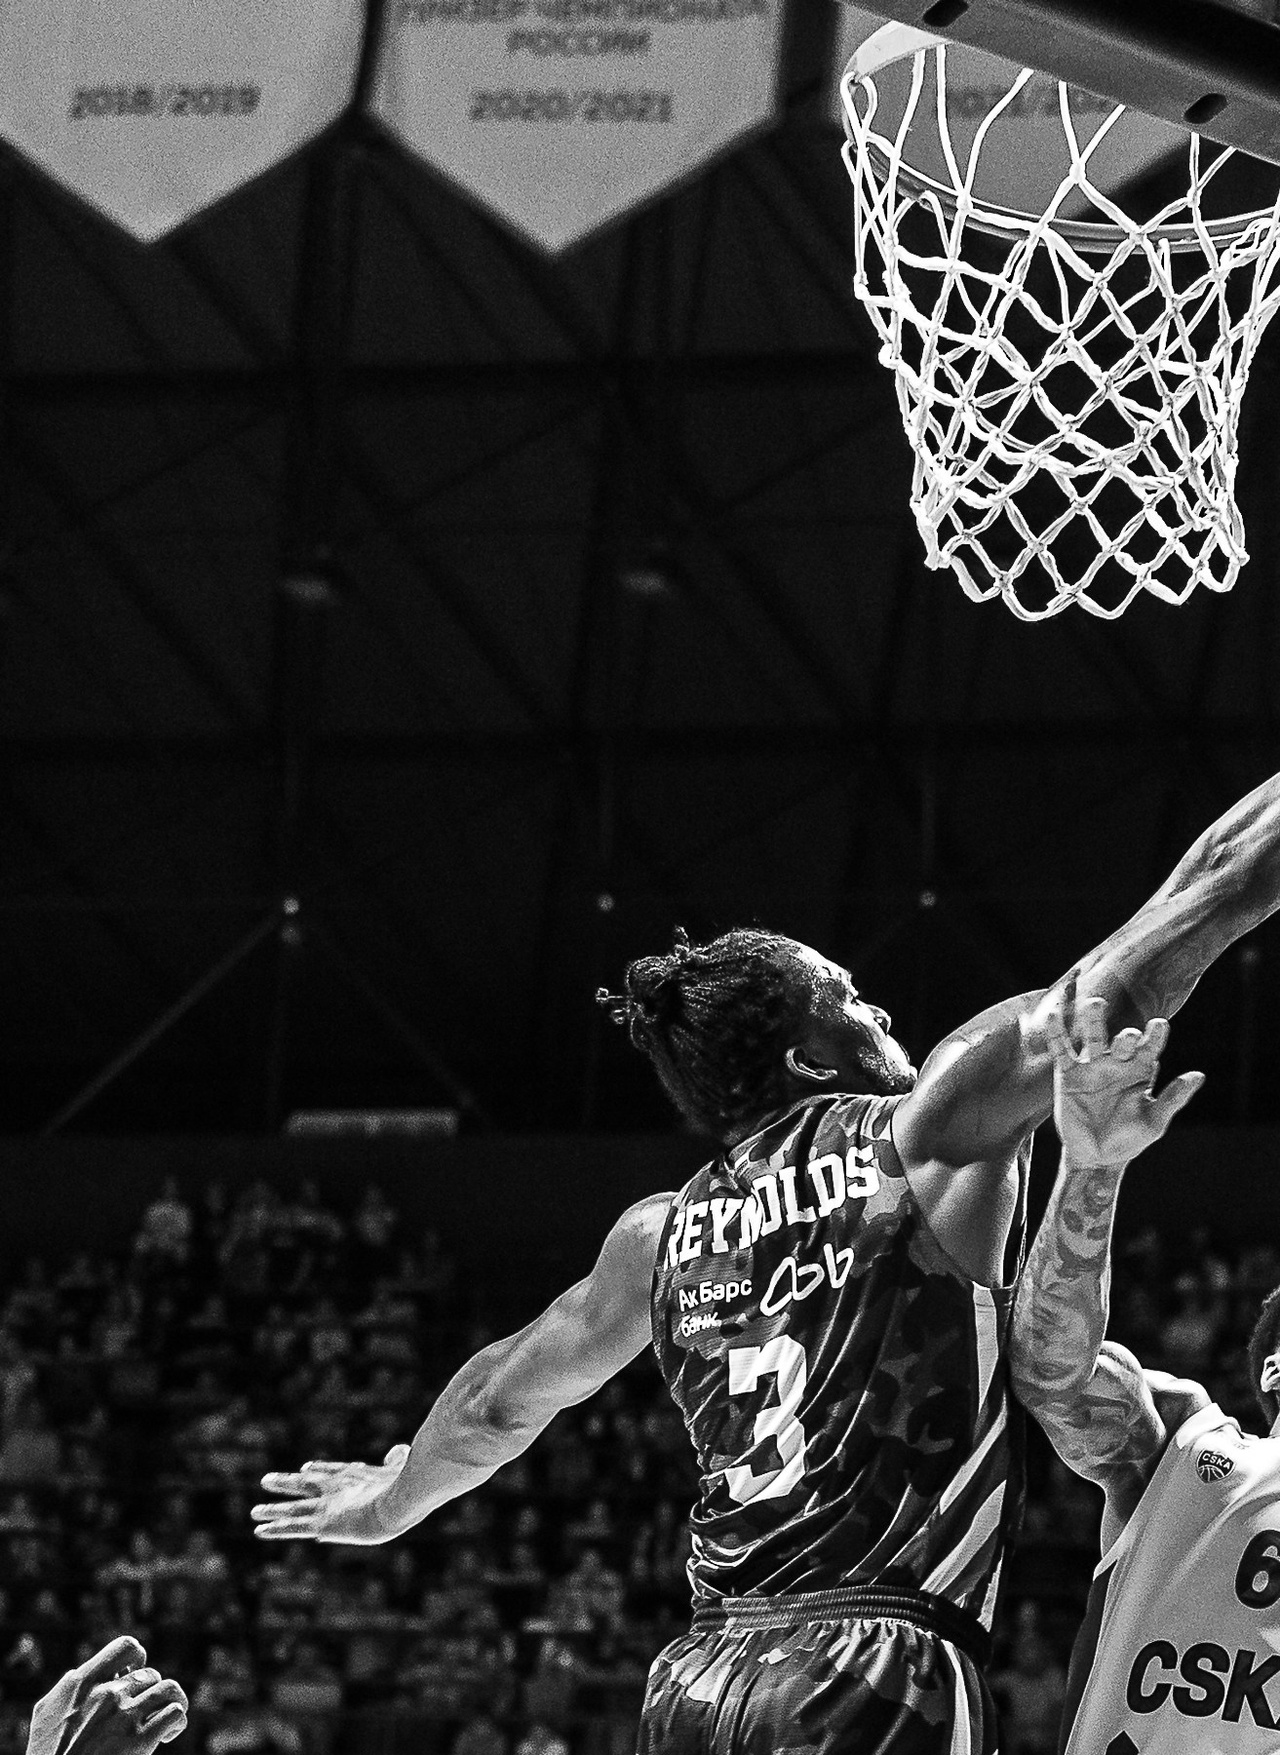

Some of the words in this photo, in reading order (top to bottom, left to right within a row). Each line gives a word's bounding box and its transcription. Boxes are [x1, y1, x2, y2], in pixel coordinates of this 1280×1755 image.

[663, 1145, 880, 1272] REYNOLDS
[699, 1279, 753, 1303] Барс
[724, 1334, 807, 1507] 3
[1202, 1452, 1231, 1470] CSKA
